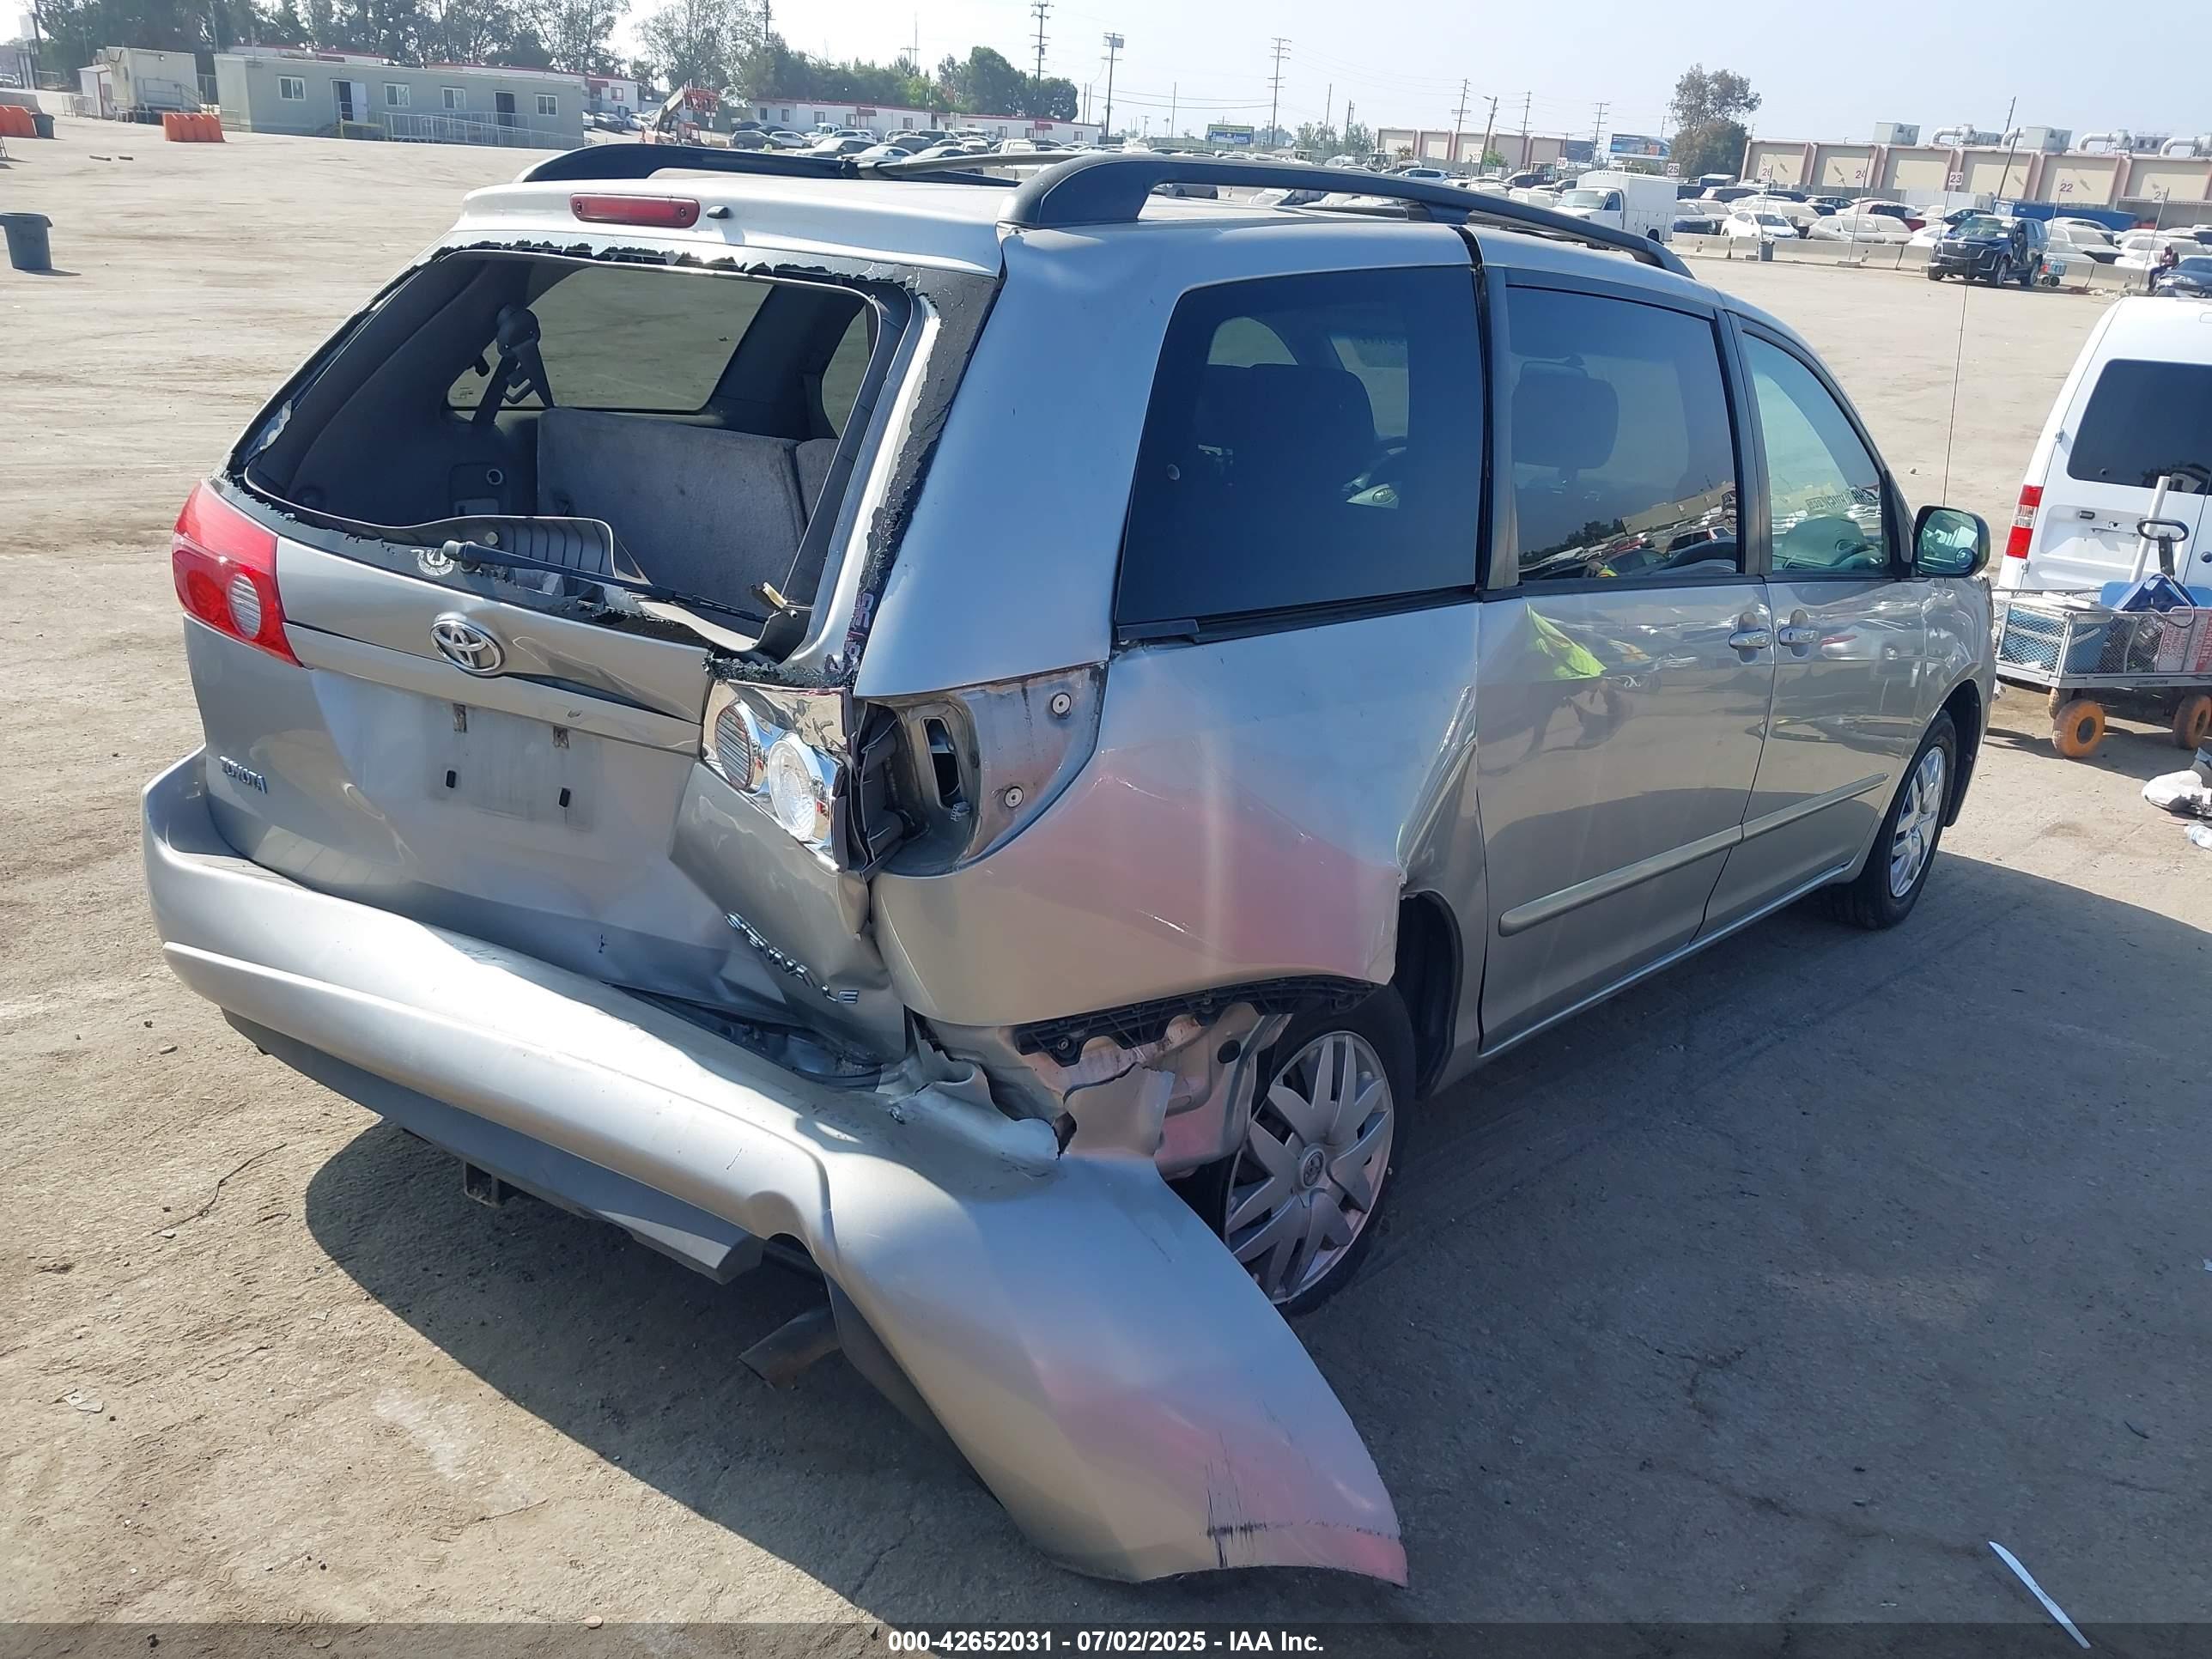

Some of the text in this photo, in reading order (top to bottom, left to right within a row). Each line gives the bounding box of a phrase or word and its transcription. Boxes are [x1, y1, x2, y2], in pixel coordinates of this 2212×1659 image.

[1668, 165, 1679, 173] 25
[1949, 174, 1962, 183] 23
[2060, 183, 2074, 192] 22
[219, 756, 268, 794] TOYOTA
